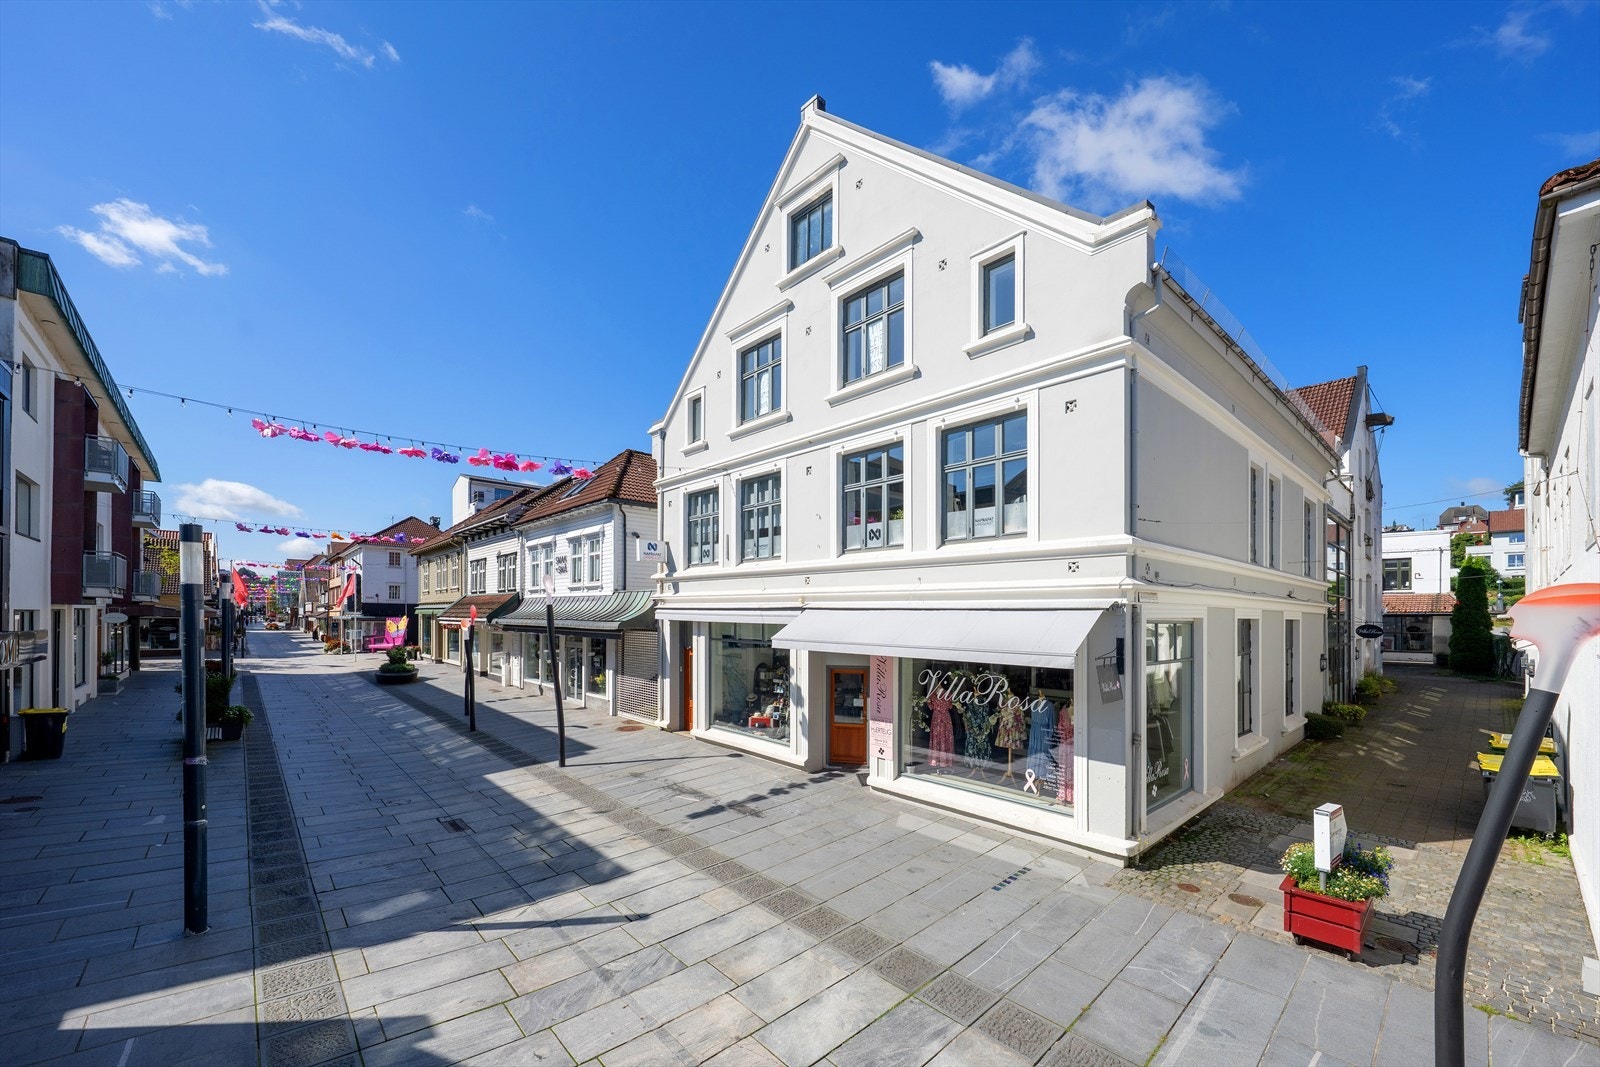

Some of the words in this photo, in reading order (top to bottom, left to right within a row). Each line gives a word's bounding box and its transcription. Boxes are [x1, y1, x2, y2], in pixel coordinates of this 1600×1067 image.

[876, 682, 888, 714] Rosa
[918, 669, 974, 704] Villa
[974, 673, 1049, 713] Rosa
